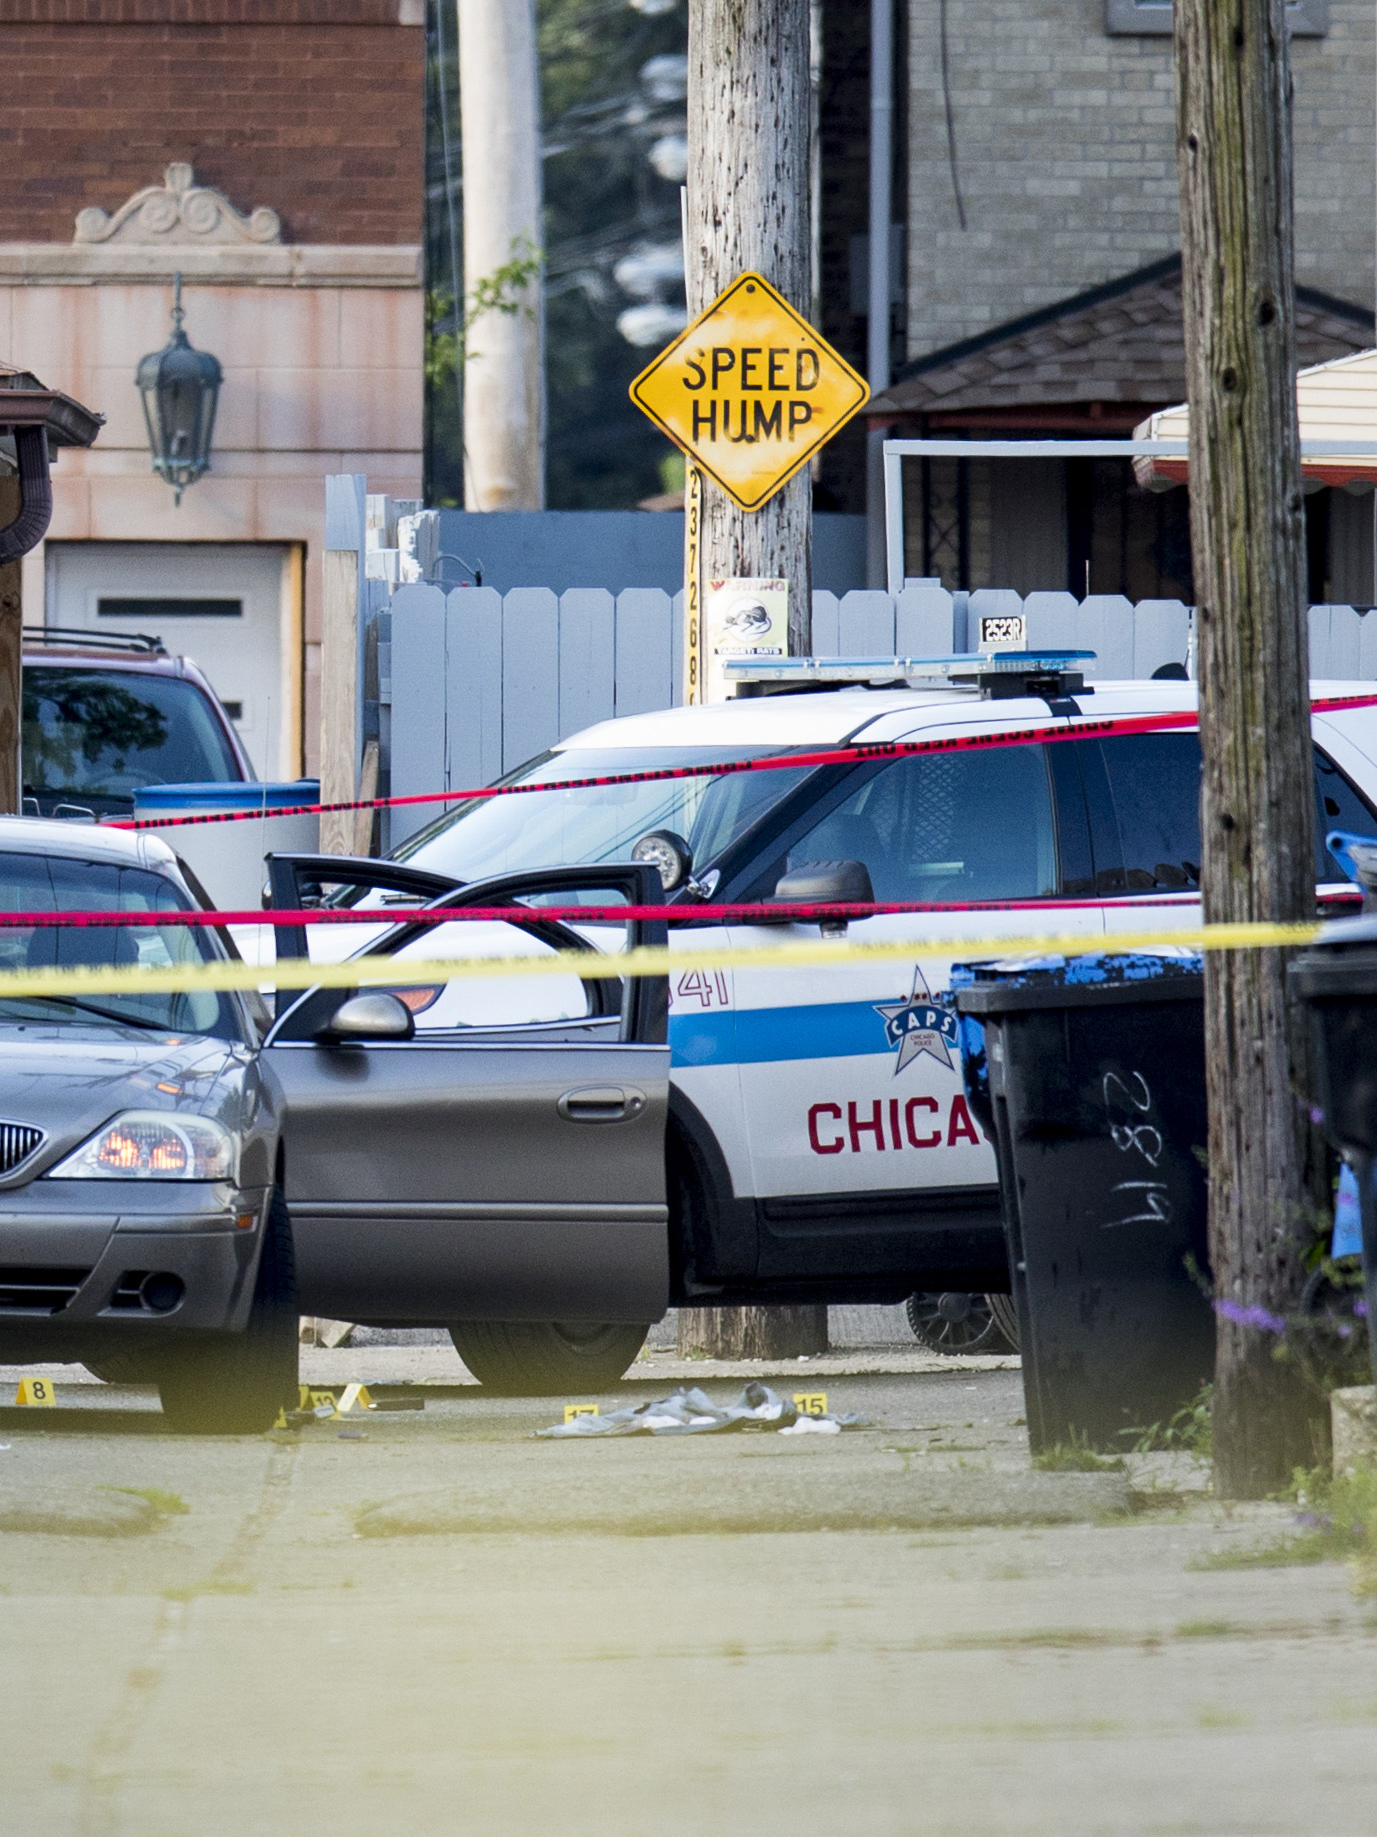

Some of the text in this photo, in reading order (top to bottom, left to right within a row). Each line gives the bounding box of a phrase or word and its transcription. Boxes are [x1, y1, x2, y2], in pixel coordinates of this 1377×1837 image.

[682, 347, 820, 391] SPEED
[692, 400, 812, 443] HUMP
[985, 617, 1021, 641] 2523R
[891, 1010, 952, 1036] CAPS
[909, 1033, 936, 1041] CHICAGO
[913, 1039, 932, 1047] POLICE
[808, 1093, 991, 1155] CHICA
[32, 1381, 47, 1400] 8
[797, 1398, 824, 1416] 15
